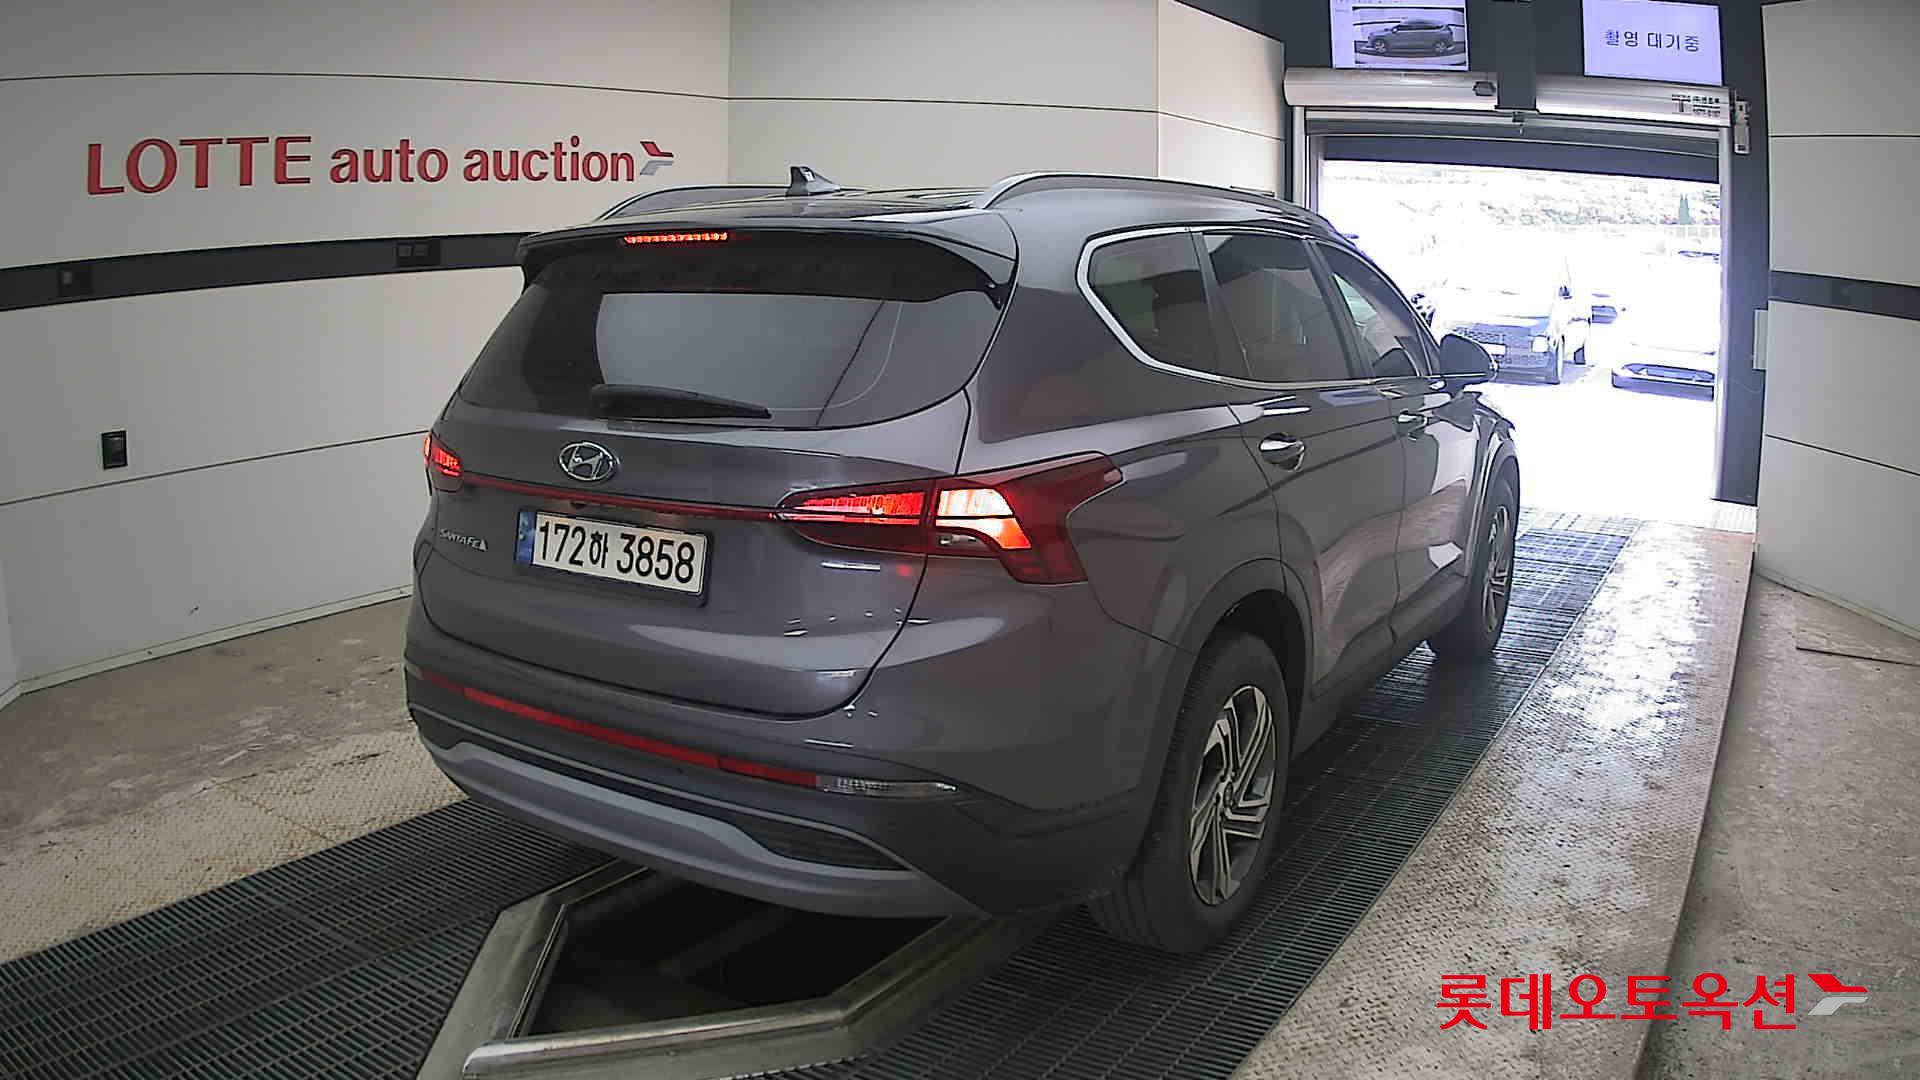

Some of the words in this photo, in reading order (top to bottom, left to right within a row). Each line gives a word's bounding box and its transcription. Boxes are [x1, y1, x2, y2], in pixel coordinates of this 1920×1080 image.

[1604, 29, 1639, 48] 촬영
[1647, 32, 1700, 52] 대기중
[87, 136, 311, 195] LOTTE
[329, 139, 448, 183] auto
[463, 135, 634, 182] auction
[539, 521, 609, 568] 172하
[616, 533, 696, 584] 3858
